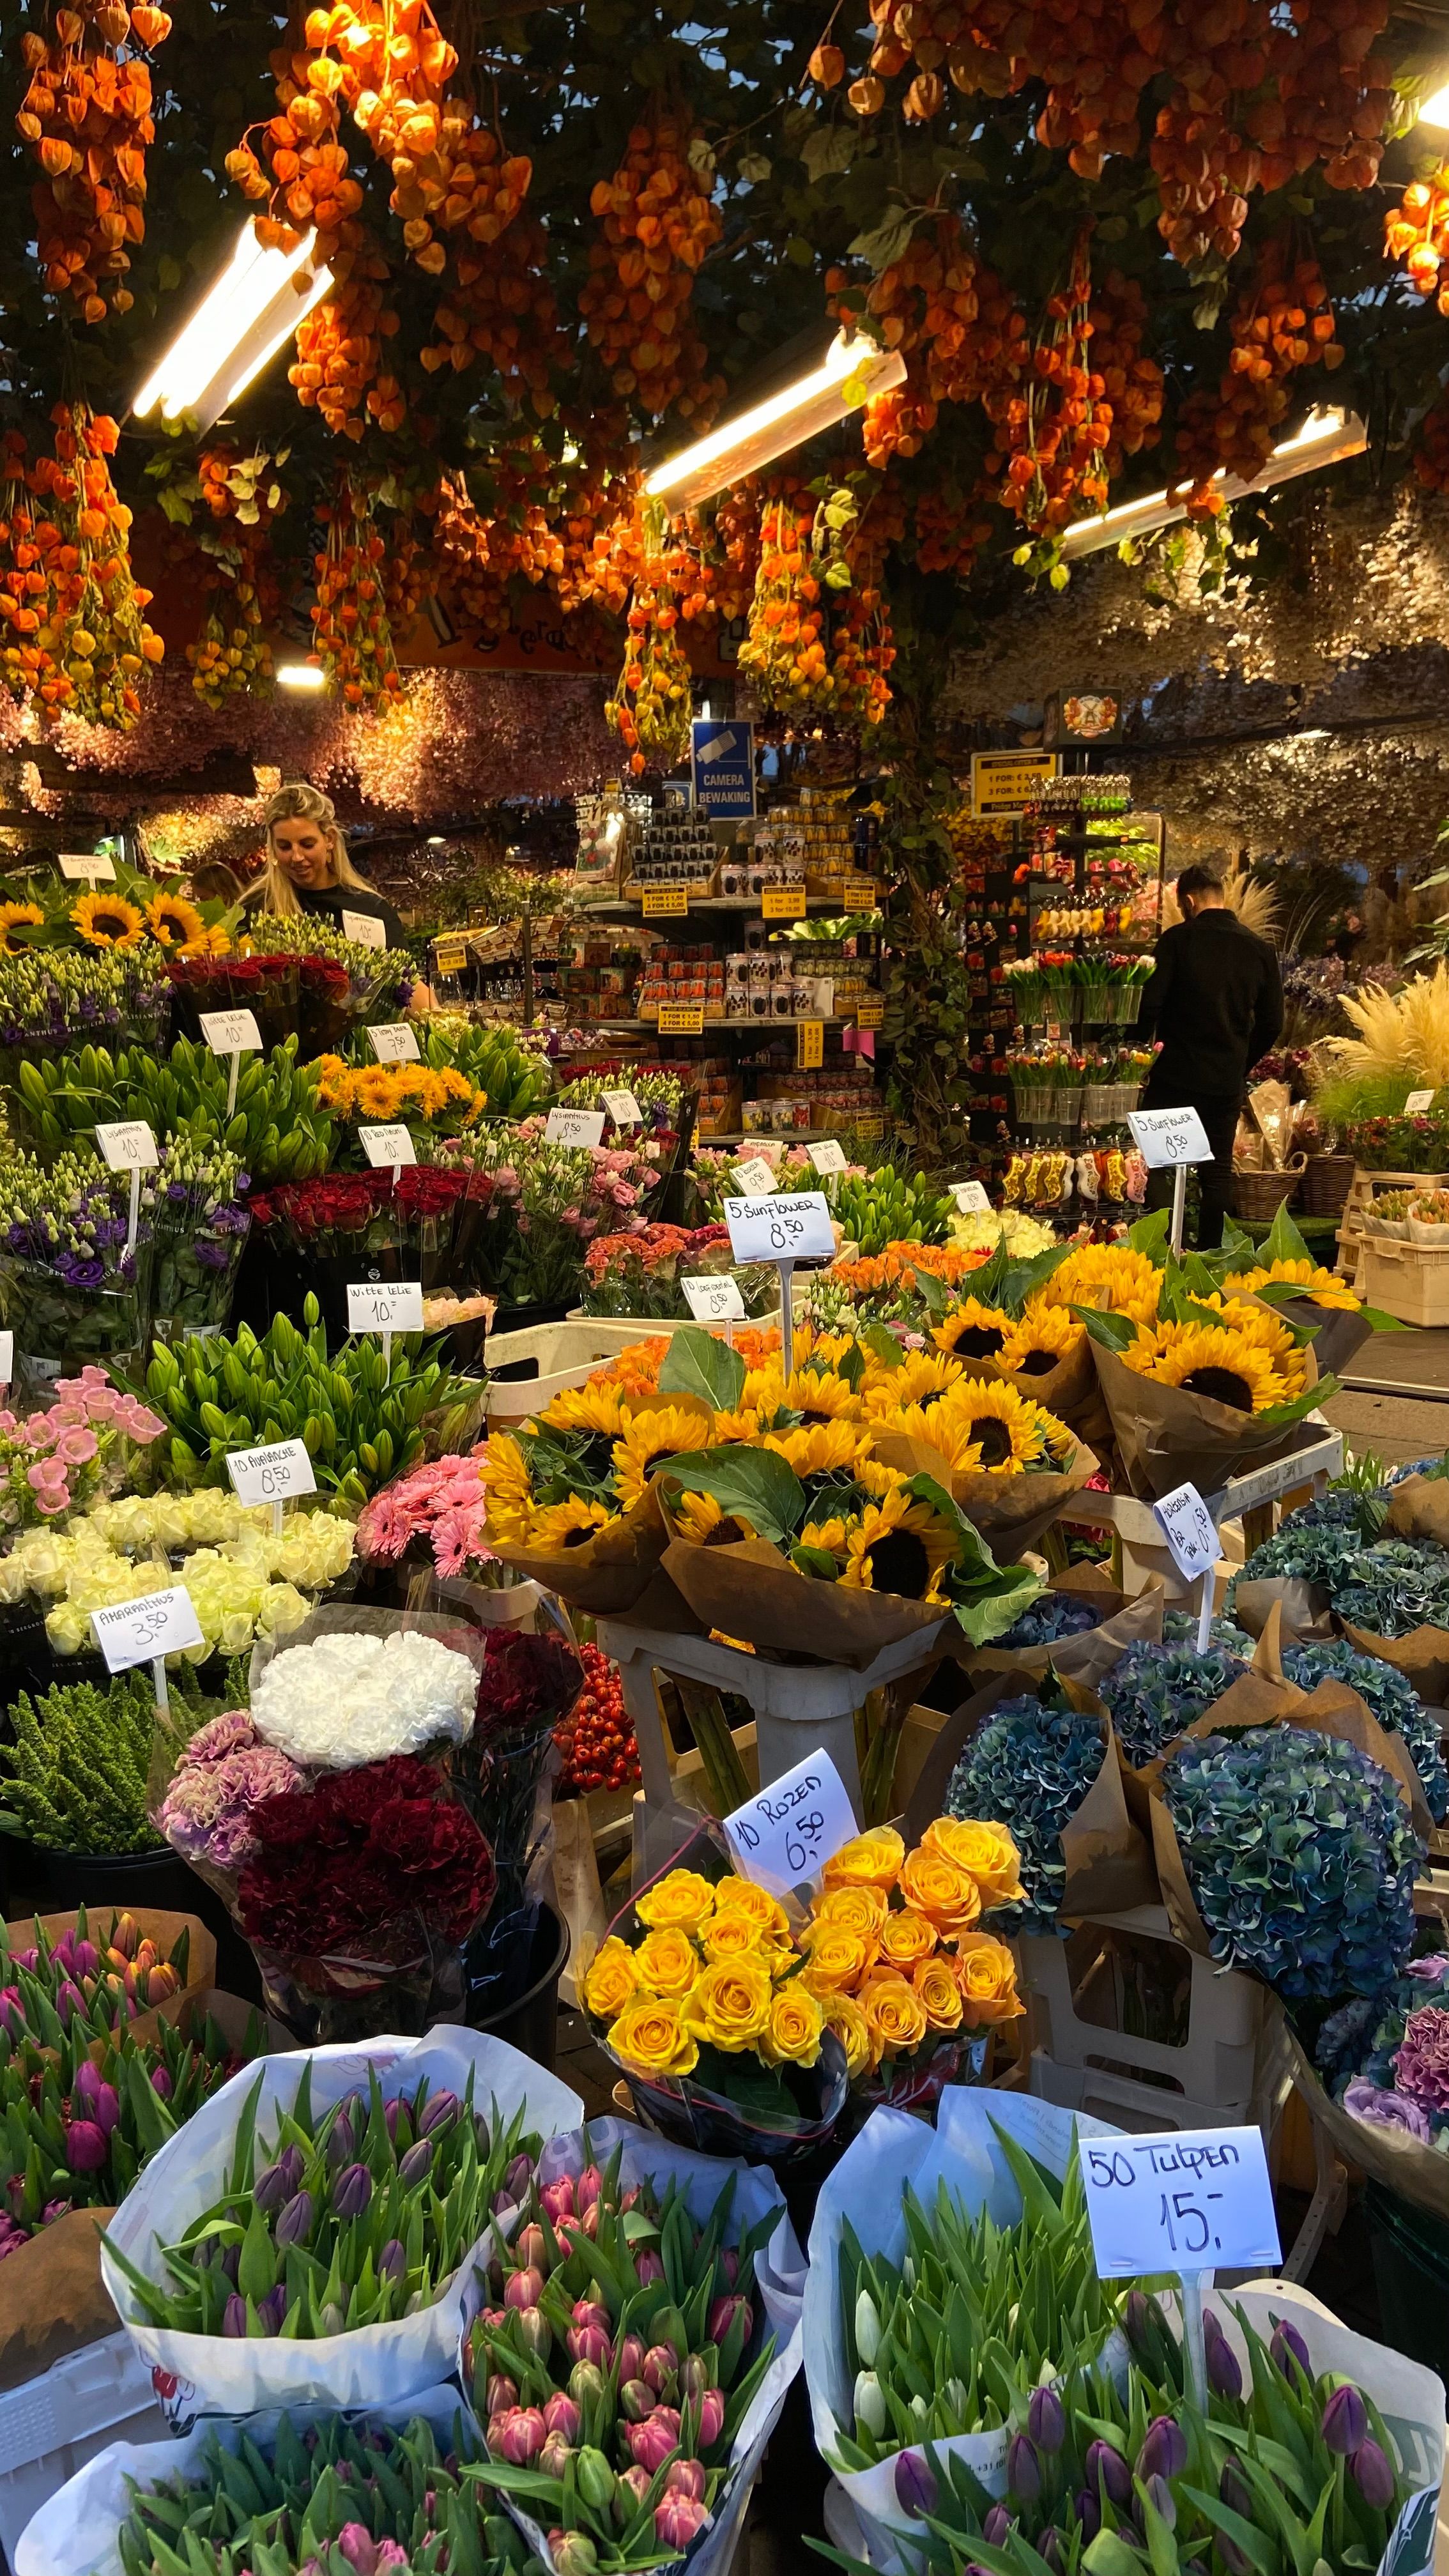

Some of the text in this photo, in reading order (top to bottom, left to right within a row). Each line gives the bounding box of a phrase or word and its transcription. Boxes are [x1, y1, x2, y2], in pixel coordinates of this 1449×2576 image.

[703, 774, 744, 786] CAMERA
[699, 792, 750, 804] BEWAKING
[371, 1029, 378, 1038] 5
[1134, 1116, 1148, 1131] 5
[363, 1130, 372, 1141] 10
[728, 1202, 742, 1218] 5
[686, 1280, 695, 1291] 10
[234, 1459, 248, 1473] 10
[735, 1820, 760, 1850] 10
[1088, 2150, 1136, 2188] 50
